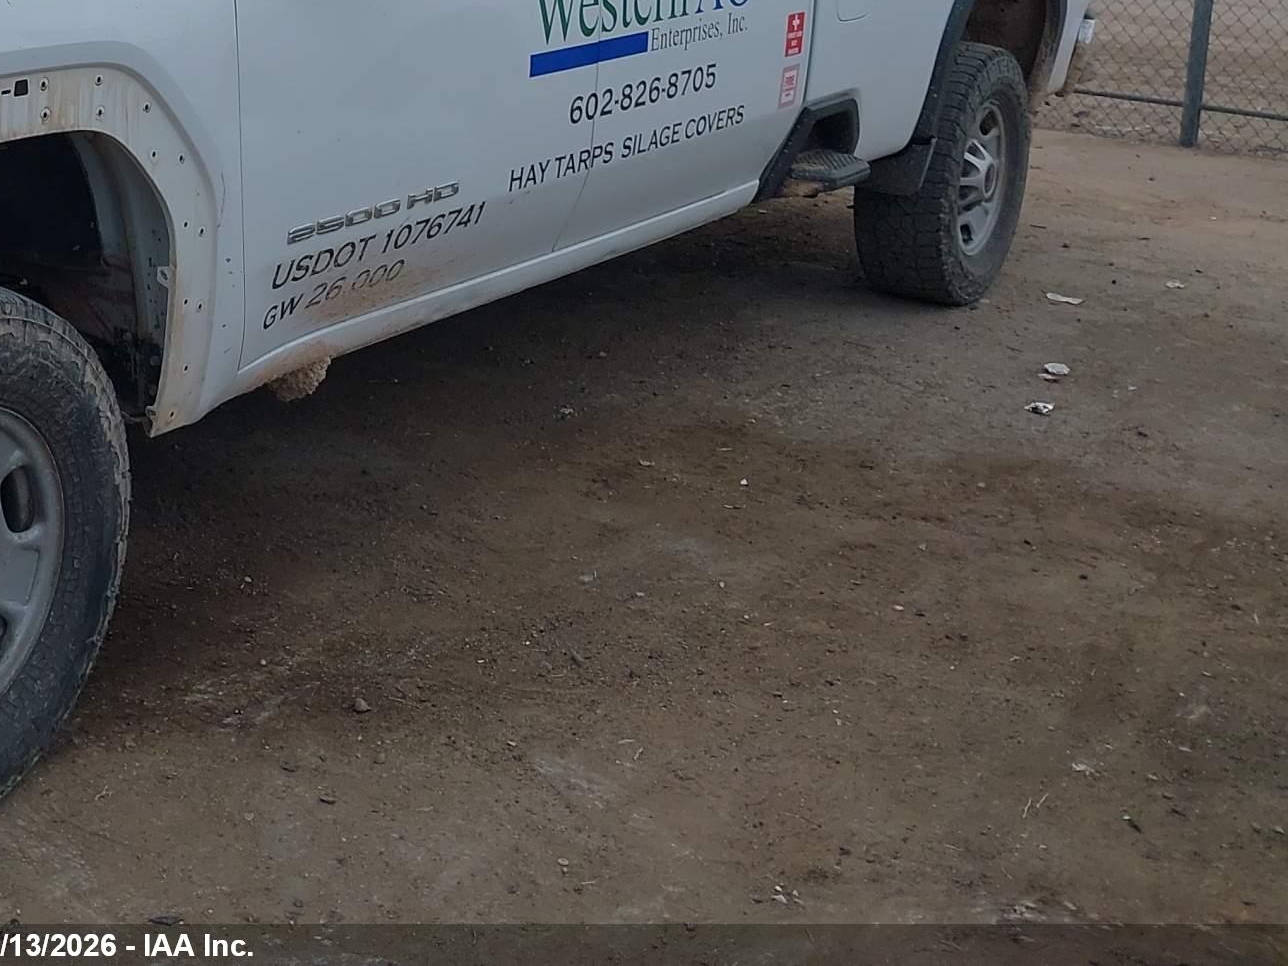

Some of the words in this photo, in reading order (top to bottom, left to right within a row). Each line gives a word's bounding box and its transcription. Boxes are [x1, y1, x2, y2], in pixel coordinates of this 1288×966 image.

[650, 15, 723, 52] Enterprises,
[727, 12, 748, 35] Inc.
[569, 63, 717, 124] 602-826-8705
[508, 158, 551, 192] HAY
[554, 142, 615, 178] TARPS
[620, 123, 683, 159] SILAGE
[684, 105, 745, 139] COVERS
[287, 198, 401, 245] 2500
[407, 180, 460, 210] HD
[271, 234, 377, 290] USDOT
[382, 201, 486, 254] 1076741
[263, 293, 304, 330] GW
